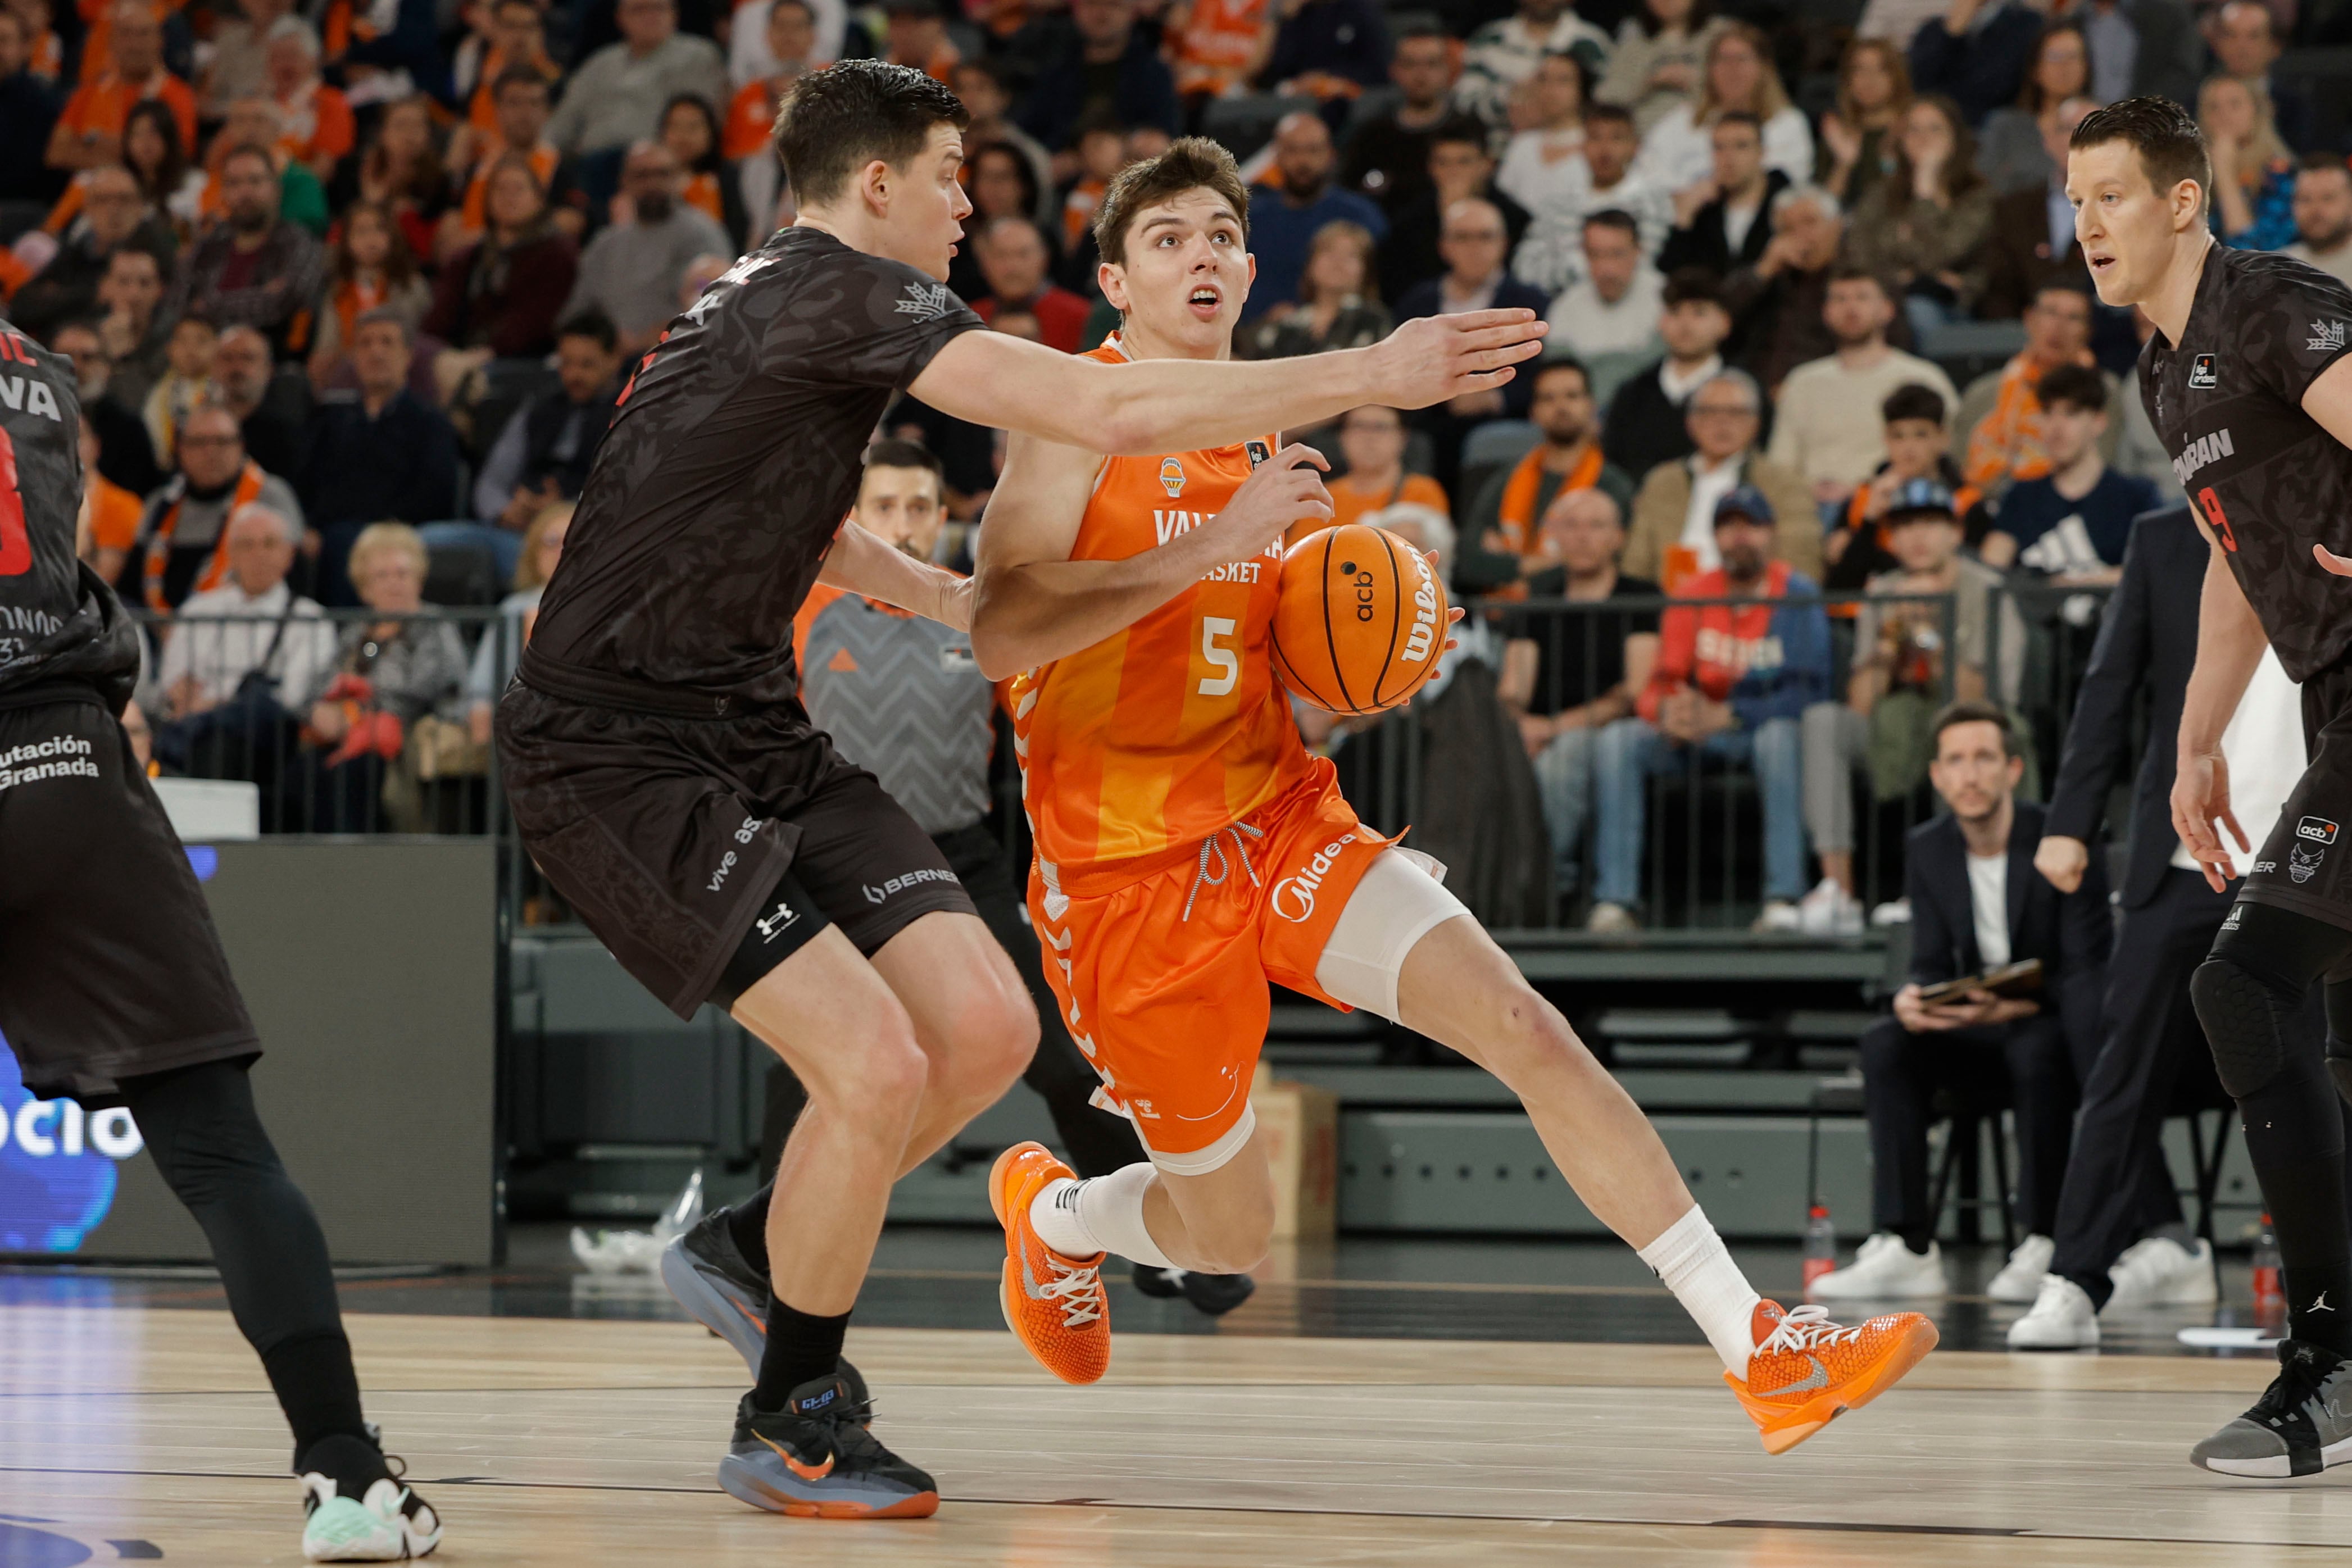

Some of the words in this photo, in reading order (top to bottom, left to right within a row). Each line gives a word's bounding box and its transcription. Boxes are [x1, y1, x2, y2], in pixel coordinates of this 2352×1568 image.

[1200, 562, 1261, 584] ASKET
[1353, 571, 1374, 622] acb
[1401, 544, 1437, 662] Wilson
[1198, 616, 1237, 696] 5
[0, 757, 99, 791] Granada
[2300, 826, 2327, 838] acb
[706, 850, 738, 892] vive
[1272, 834, 1357, 922] Midea
[0, 1098, 145, 1160] cio
